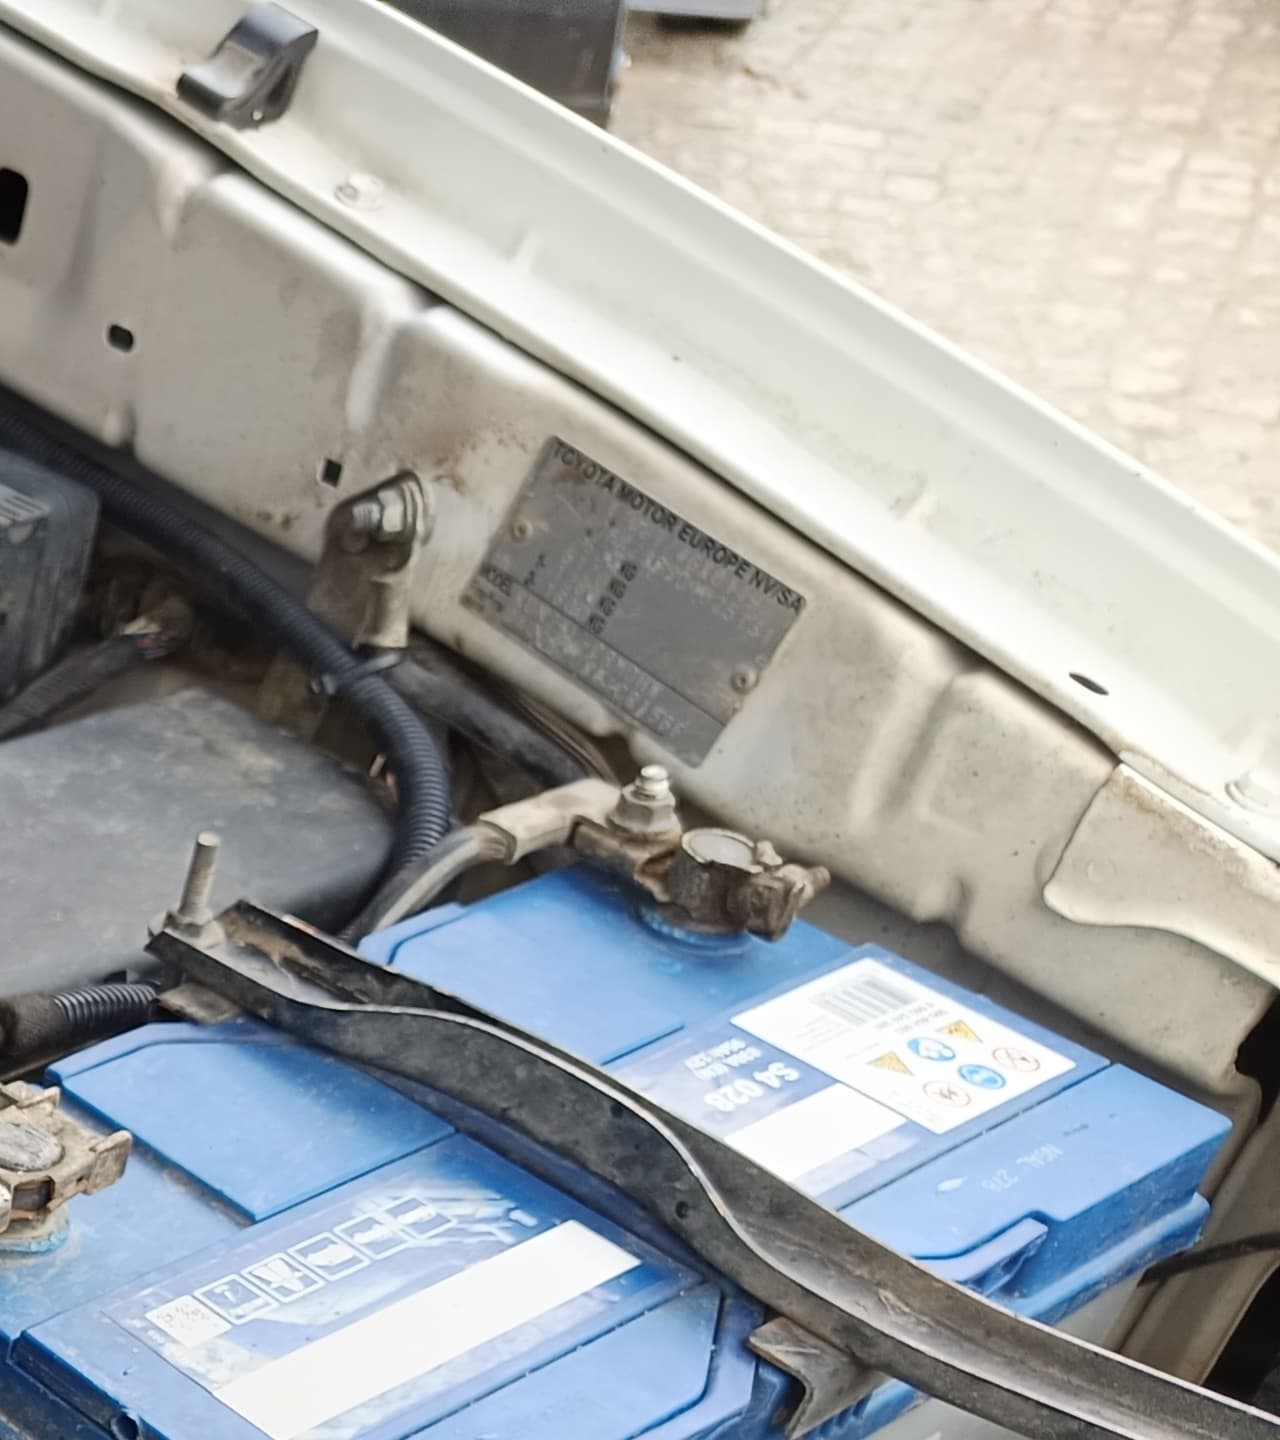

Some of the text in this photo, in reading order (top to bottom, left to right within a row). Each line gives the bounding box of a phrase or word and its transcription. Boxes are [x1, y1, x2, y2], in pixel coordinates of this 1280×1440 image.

[616, 480, 675, 534] MOTOR
[678, 523, 749, 580] EUROPE
[748, 567, 806, 614] NV/SA
